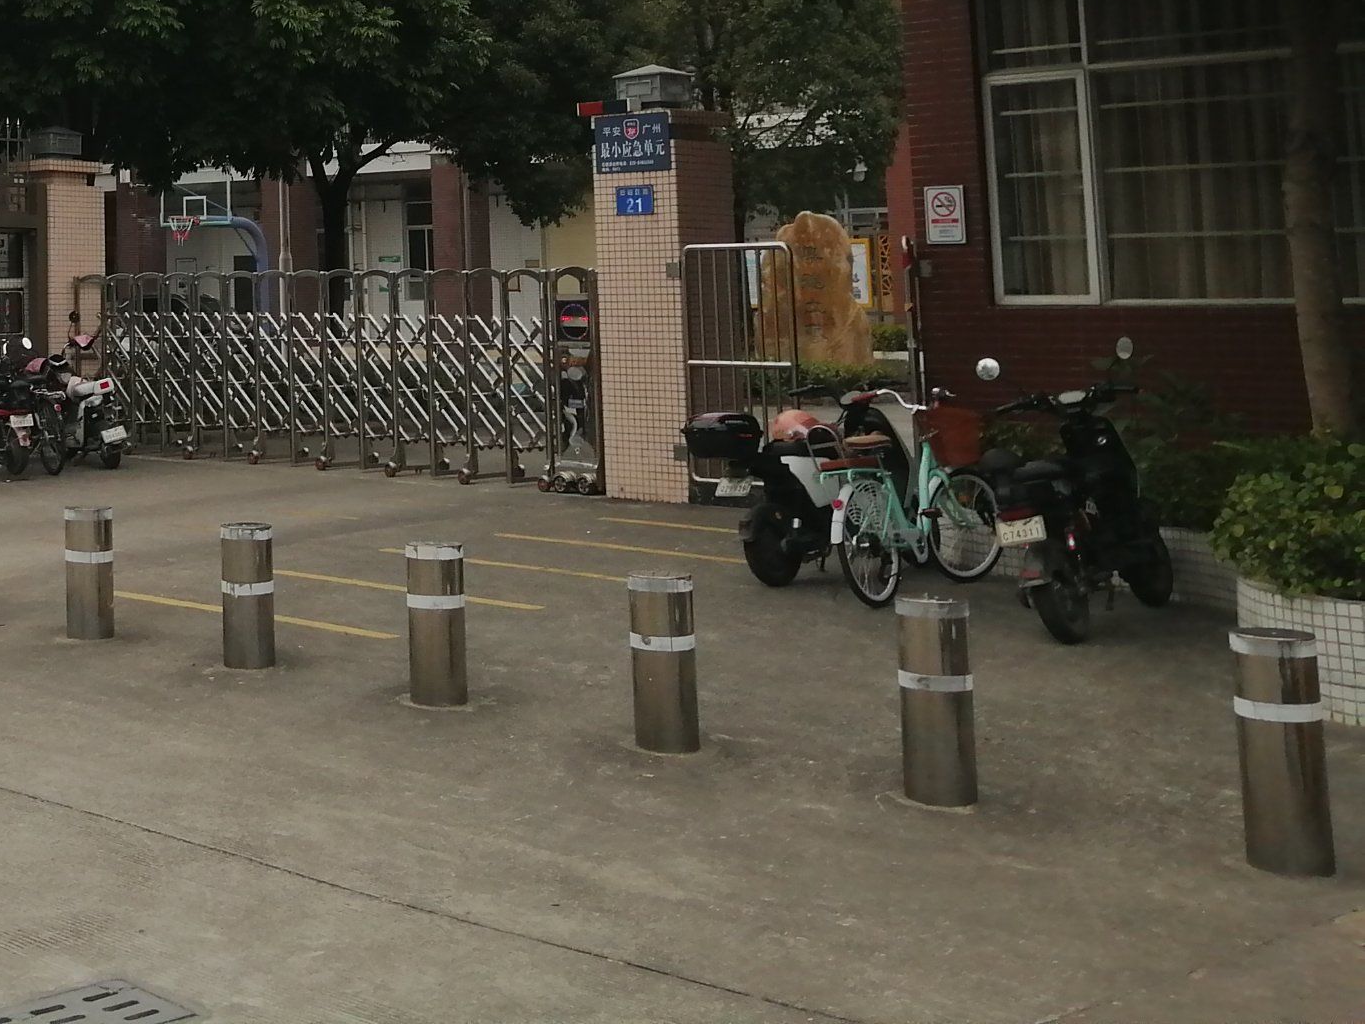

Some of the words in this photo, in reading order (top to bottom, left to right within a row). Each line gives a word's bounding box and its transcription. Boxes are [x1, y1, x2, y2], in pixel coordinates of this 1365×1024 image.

[602, 126, 622, 137] 平安
[641, 123, 661, 134] 广州
[600, 139, 665, 159] 最小应急单元
[626, 198, 643, 213] 21
